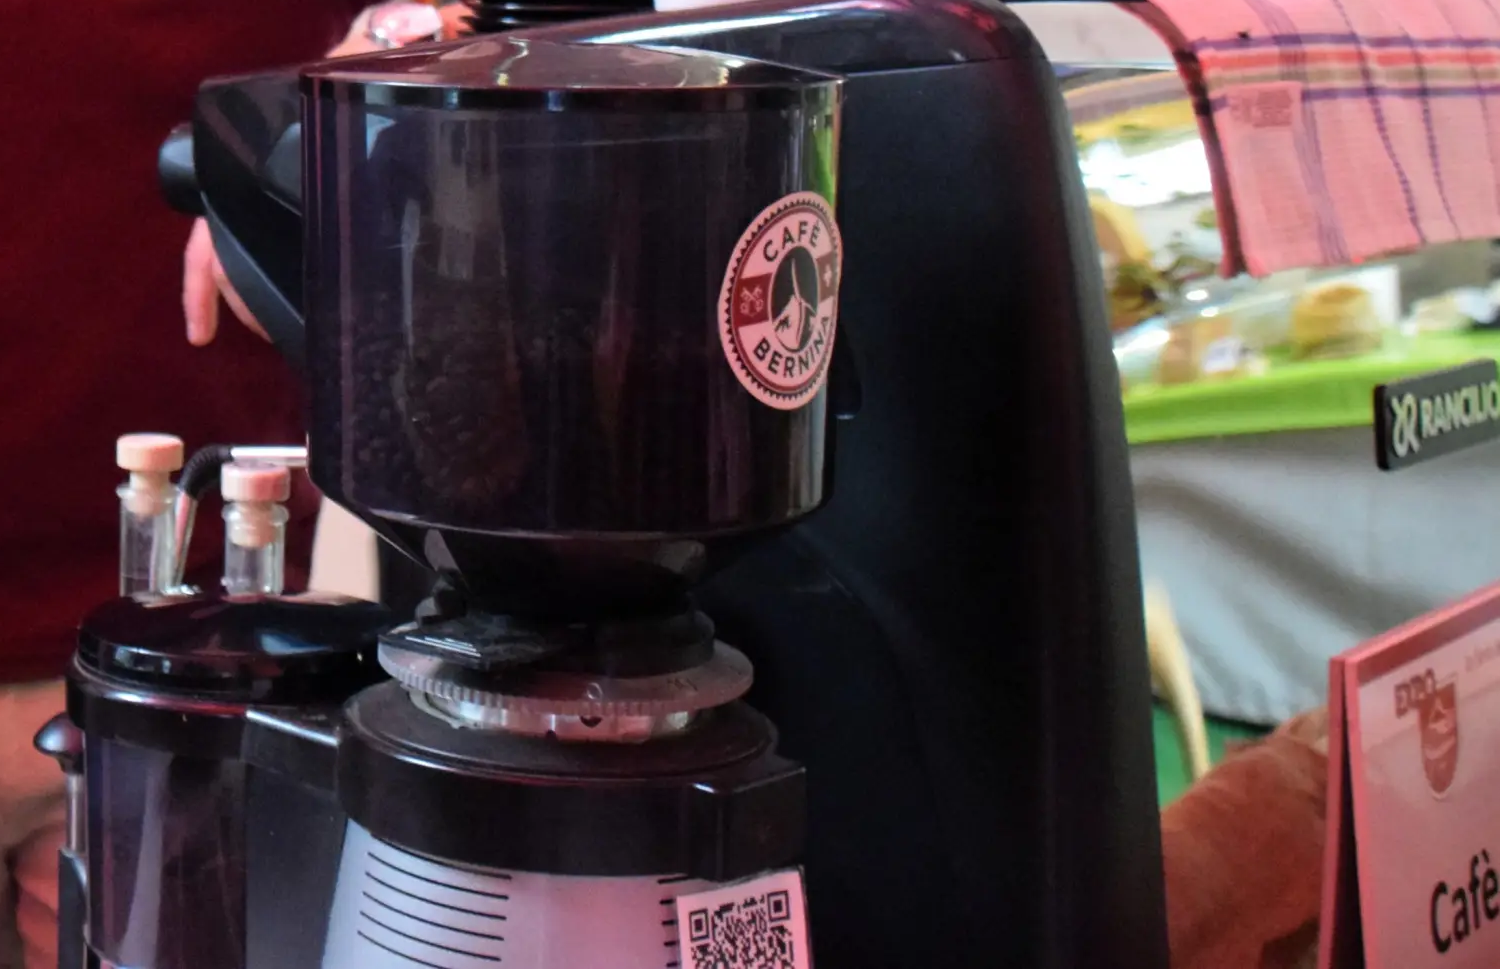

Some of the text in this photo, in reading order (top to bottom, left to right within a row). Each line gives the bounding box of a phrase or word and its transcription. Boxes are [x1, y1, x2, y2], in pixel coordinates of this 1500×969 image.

[752, 316, 831, 379] BERNINA
[1420, 381, 1500, 439] RANCILIO
[1430, 848, 1500, 954] Cafè
